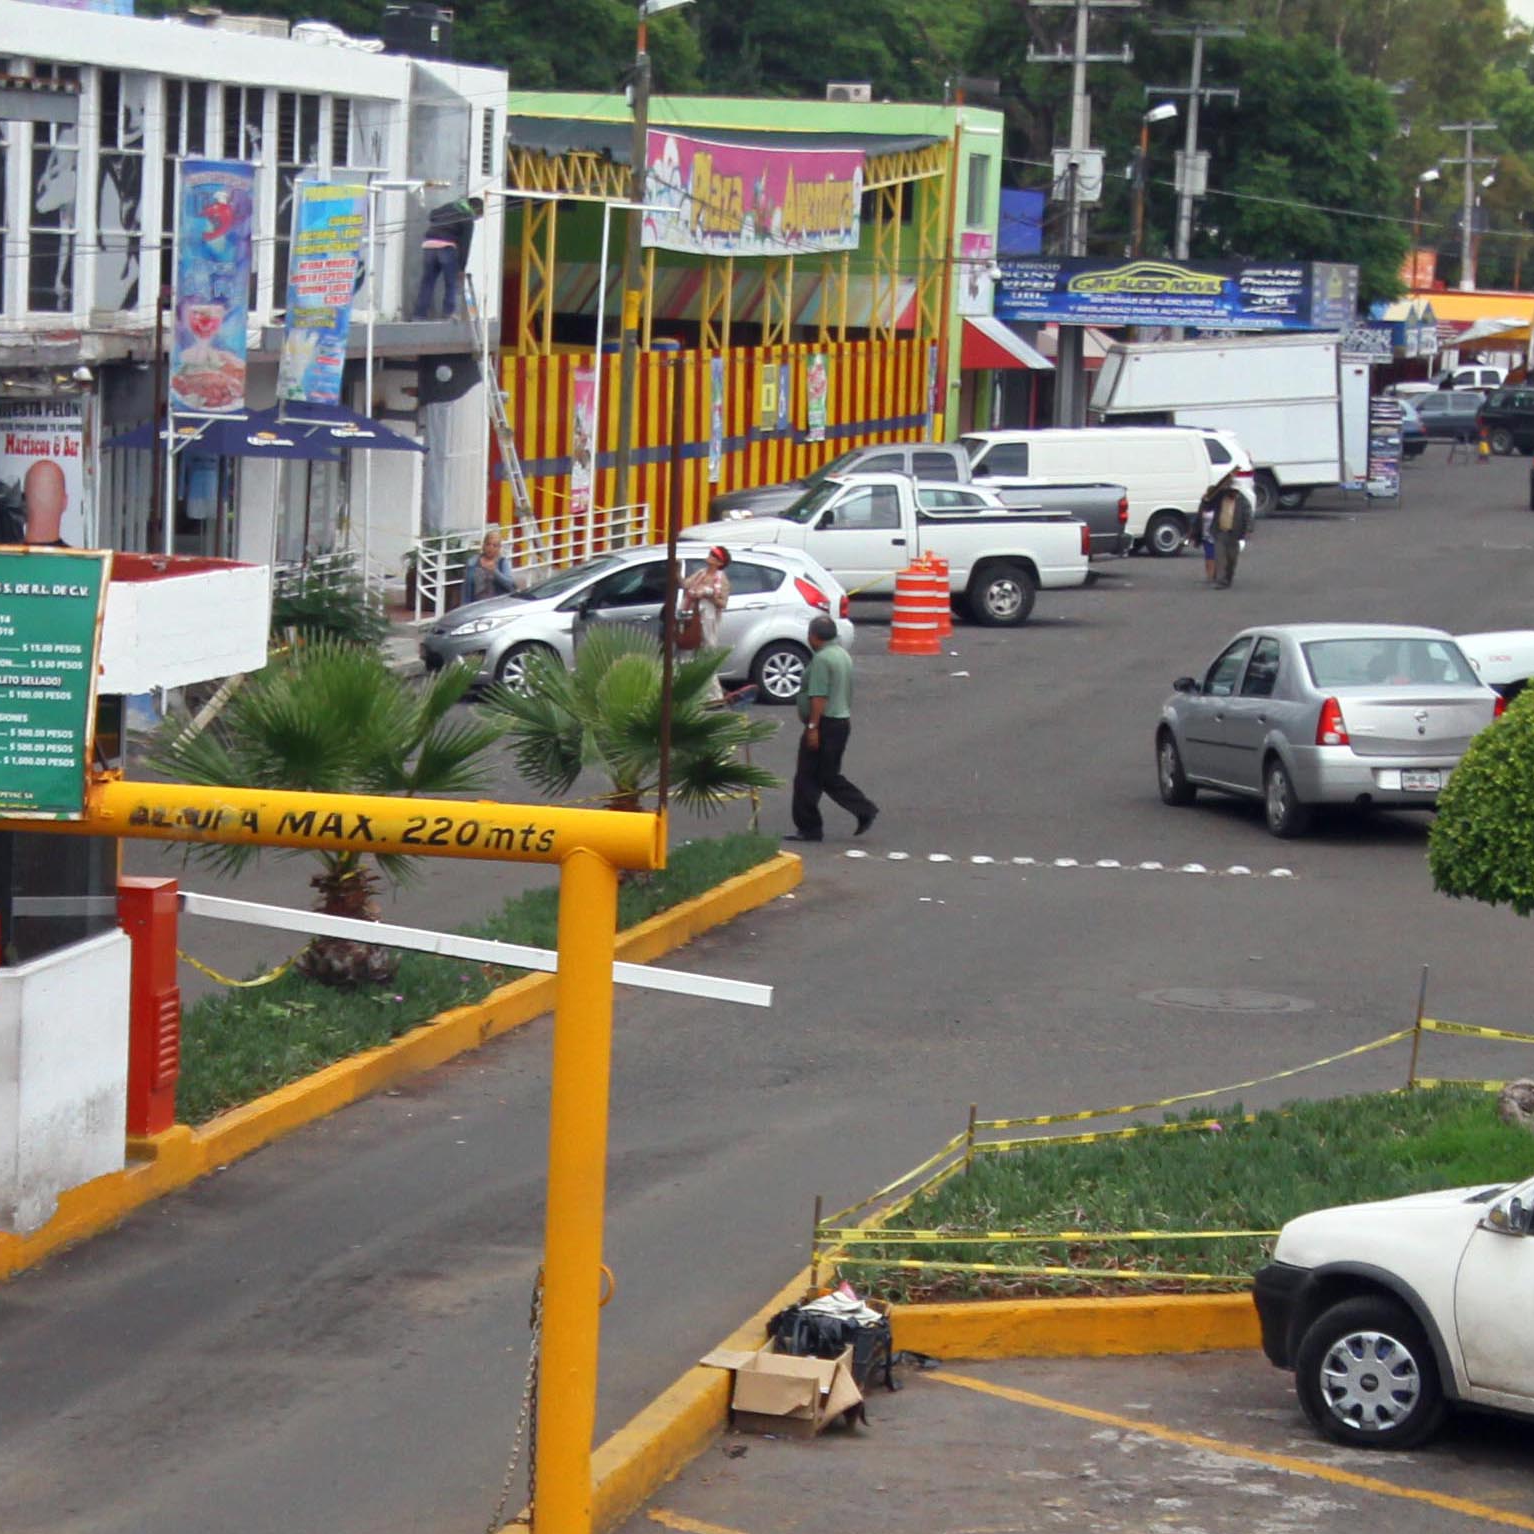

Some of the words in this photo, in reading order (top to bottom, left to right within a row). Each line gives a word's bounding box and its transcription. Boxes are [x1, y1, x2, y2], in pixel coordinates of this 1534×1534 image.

[1000, 271, 1057, 280] SONY
[1001, 280, 1056, 289] VIPER
[4, 433, 50, 456] Mariscos
[3, 583, 13, 594] S.
[15, 584, 29, 594] DE
[31, 585, 50, 595] R.L.
[52, 586, 67, 596] DE
[69, 586, 89, 597] C.V.
[54, 644, 82, 654] PESOS
[56, 660, 83, 670] PESOS
[45, 691, 72, 700] PESOS
[46, 729, 74, 738] PESOS
[46, 744, 73, 753] PESOS
[48, 757, 75, 767] PESOS
[276, 810, 386, 842] MAX.
[402, 816, 479, 847] 220
[484, 823, 556, 853] mts
